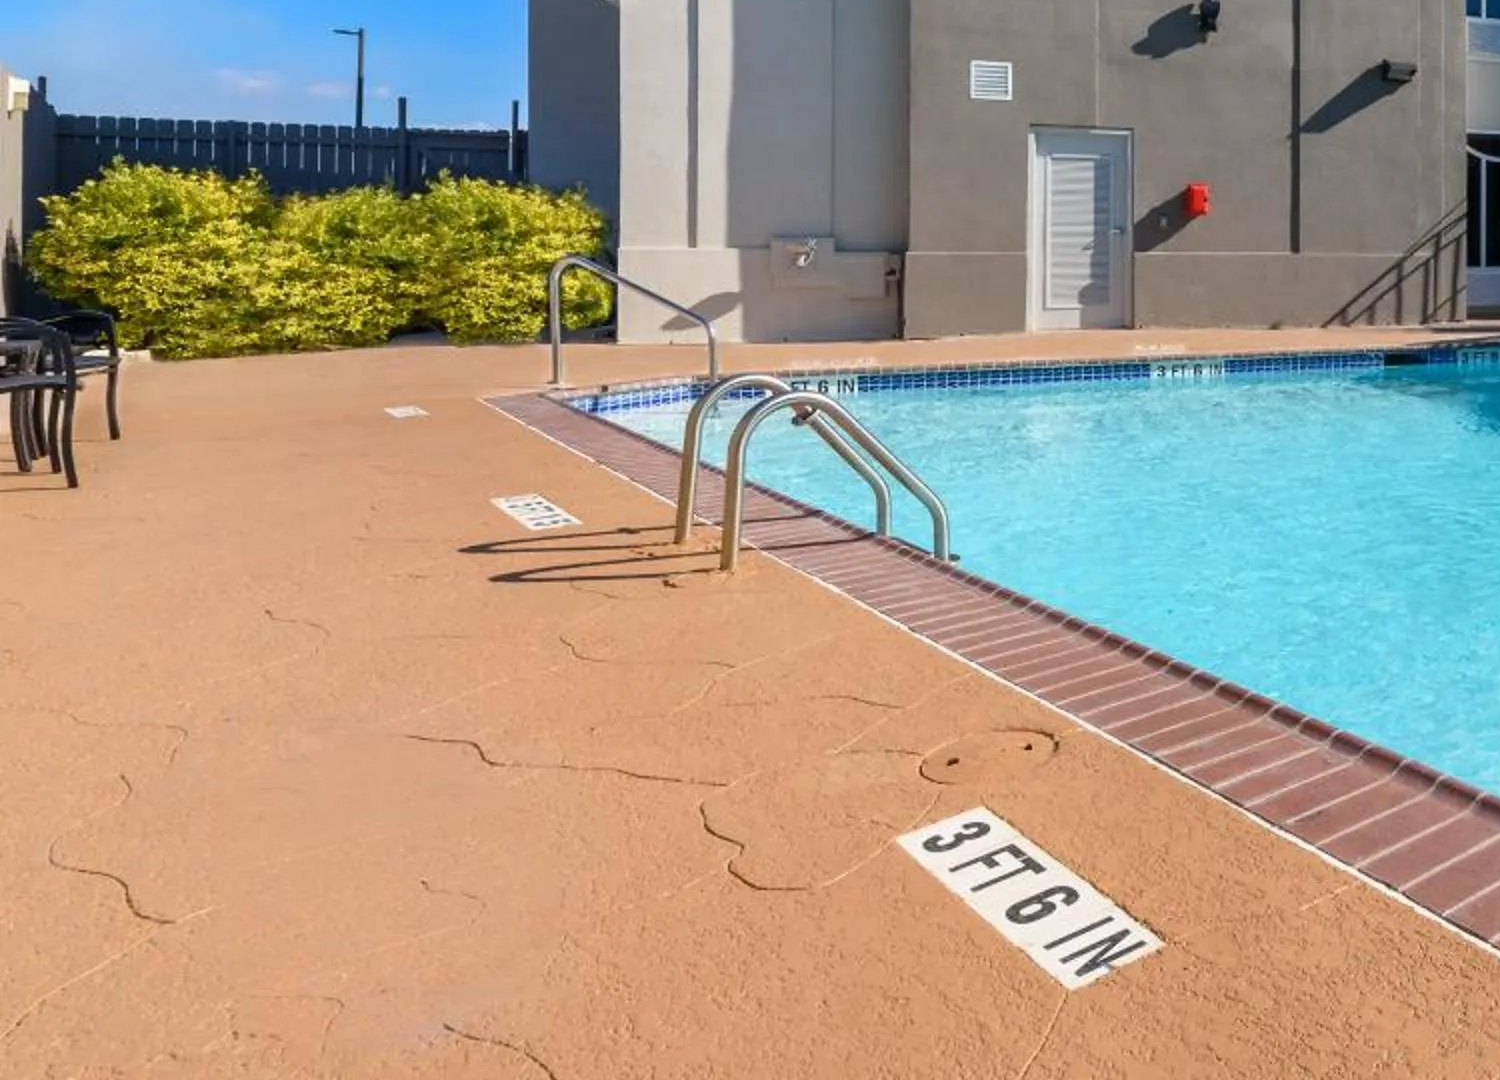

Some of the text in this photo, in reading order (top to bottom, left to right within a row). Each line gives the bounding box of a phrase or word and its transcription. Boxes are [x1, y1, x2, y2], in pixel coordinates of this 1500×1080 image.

[818, 379, 830, 393] 6
[837, 379, 855, 393] IN
[921, 821, 1147, 977] 3 FT 6 IN
